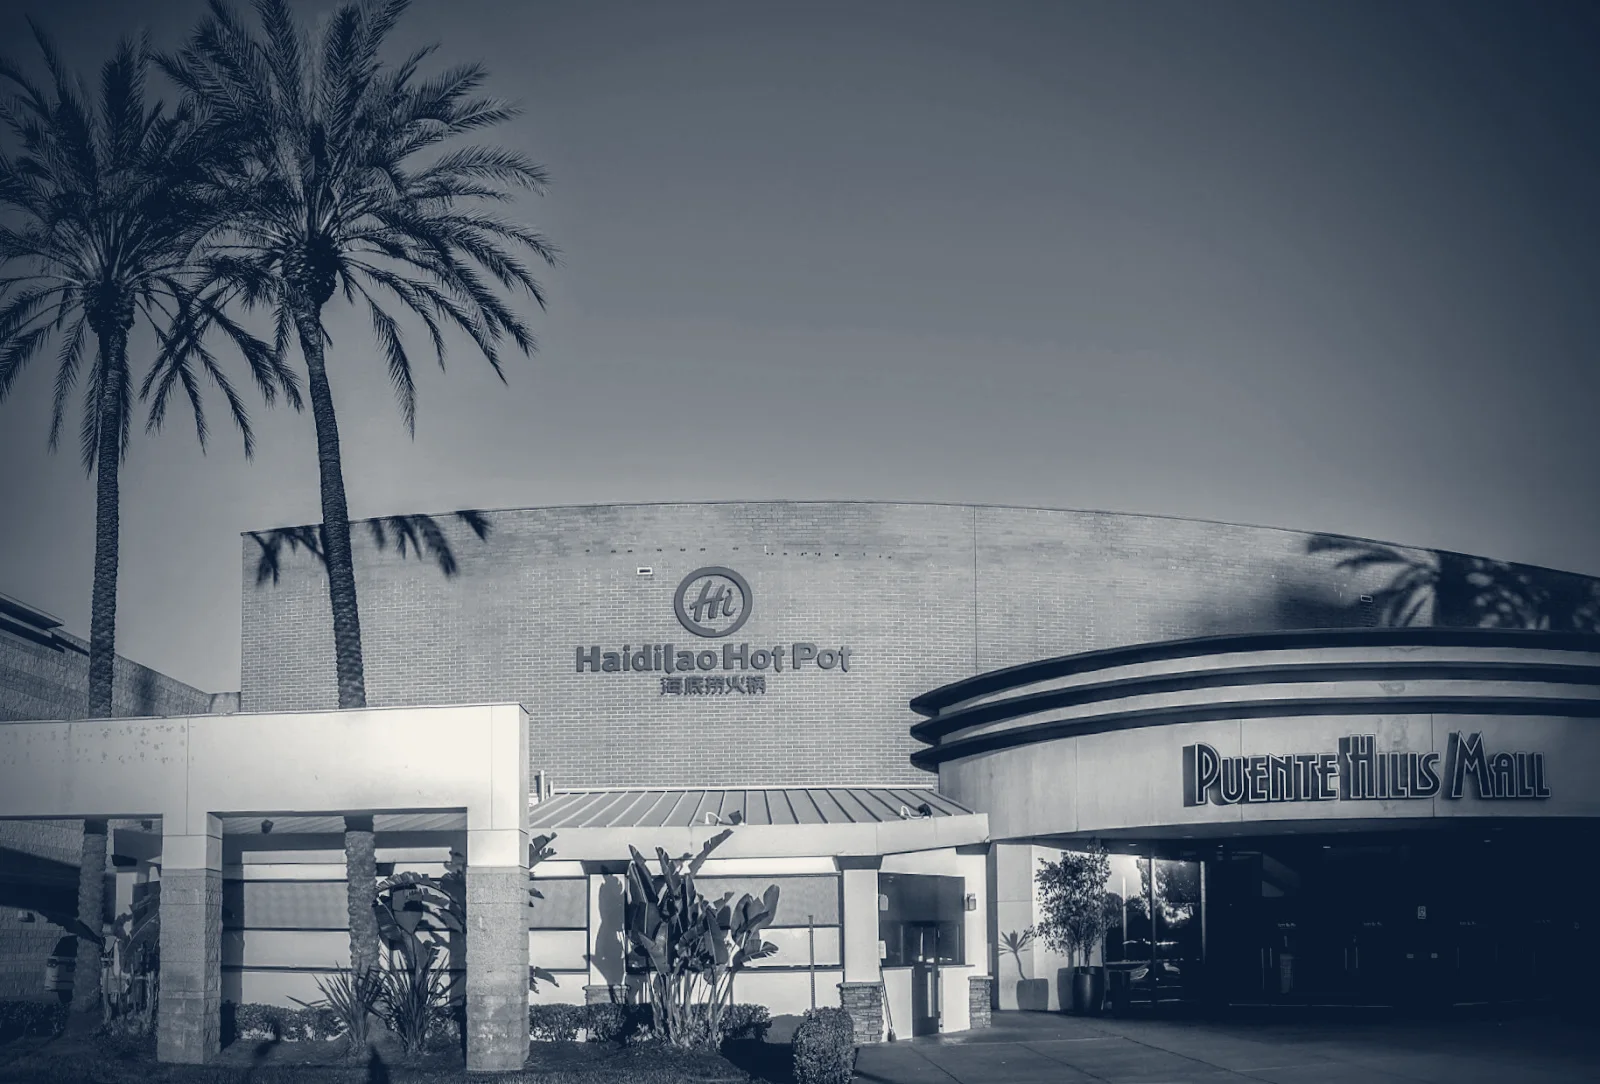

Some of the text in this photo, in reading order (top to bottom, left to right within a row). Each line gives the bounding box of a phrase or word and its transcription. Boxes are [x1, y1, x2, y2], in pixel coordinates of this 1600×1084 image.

[689, 579, 736, 622] Hi
[576, 642, 852, 674] Haidilao Hot Pot
[1190, 730, 1551, 805] PUENTE HILLS MALL
